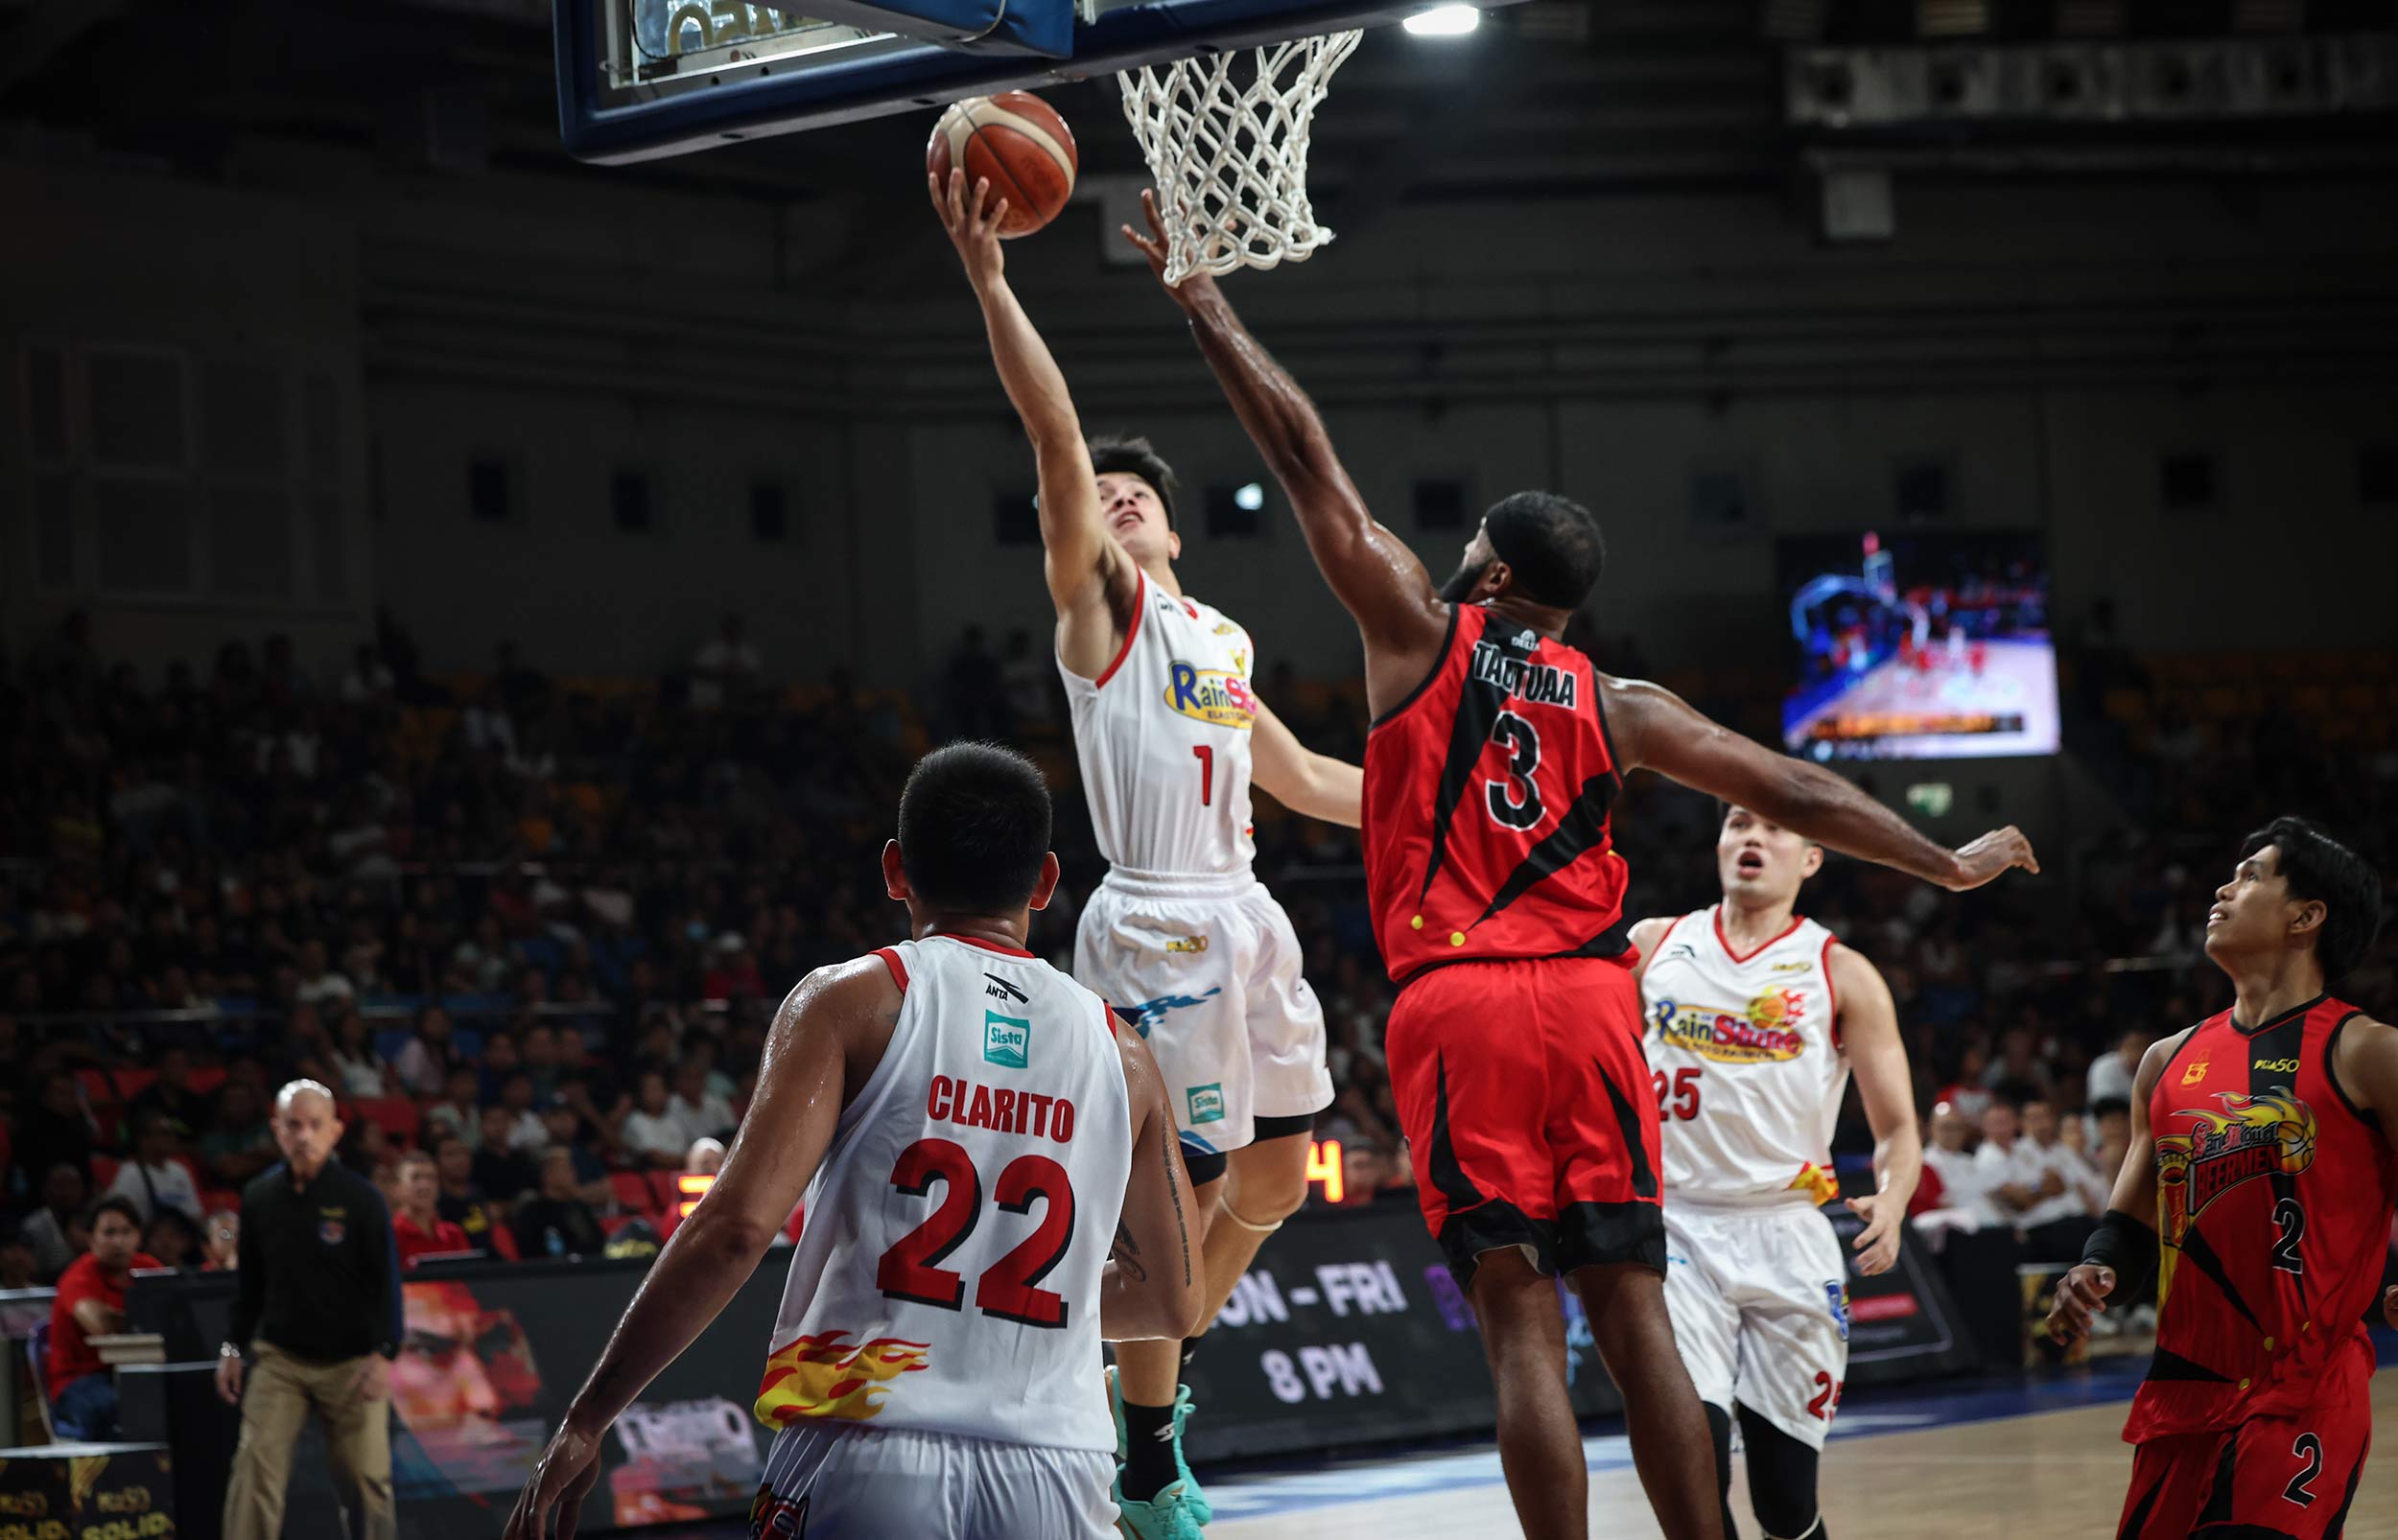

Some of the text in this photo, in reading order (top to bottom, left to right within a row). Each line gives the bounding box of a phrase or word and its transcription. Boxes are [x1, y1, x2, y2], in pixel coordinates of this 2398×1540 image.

[1169, 662, 1231, 712] Rain
[1193, 744, 1212, 806] 1
[1486, 710, 1547, 832] 3
[985, 983, 1009, 1002] ANTA
[1657, 999, 1711, 1040] Rain
[990, 1026, 1023, 1045] Sista
[928, 1074, 1075, 1143] CLARITO
[1652, 1067, 1702, 1121] 25
[1305, 1138, 1344, 1203] 4
[2195, 1145, 2282, 1210] BEERMEN
[877, 1137, 1076, 1329] 22
[2272, 1198, 2306, 1274] 2
[1210, 1269, 1290, 1329] ON
[1315, 1258, 1409, 1318] FRI
[1260, 1342, 1384, 1404] 8 PM
[2282, 1431, 2323, 1508] 2
